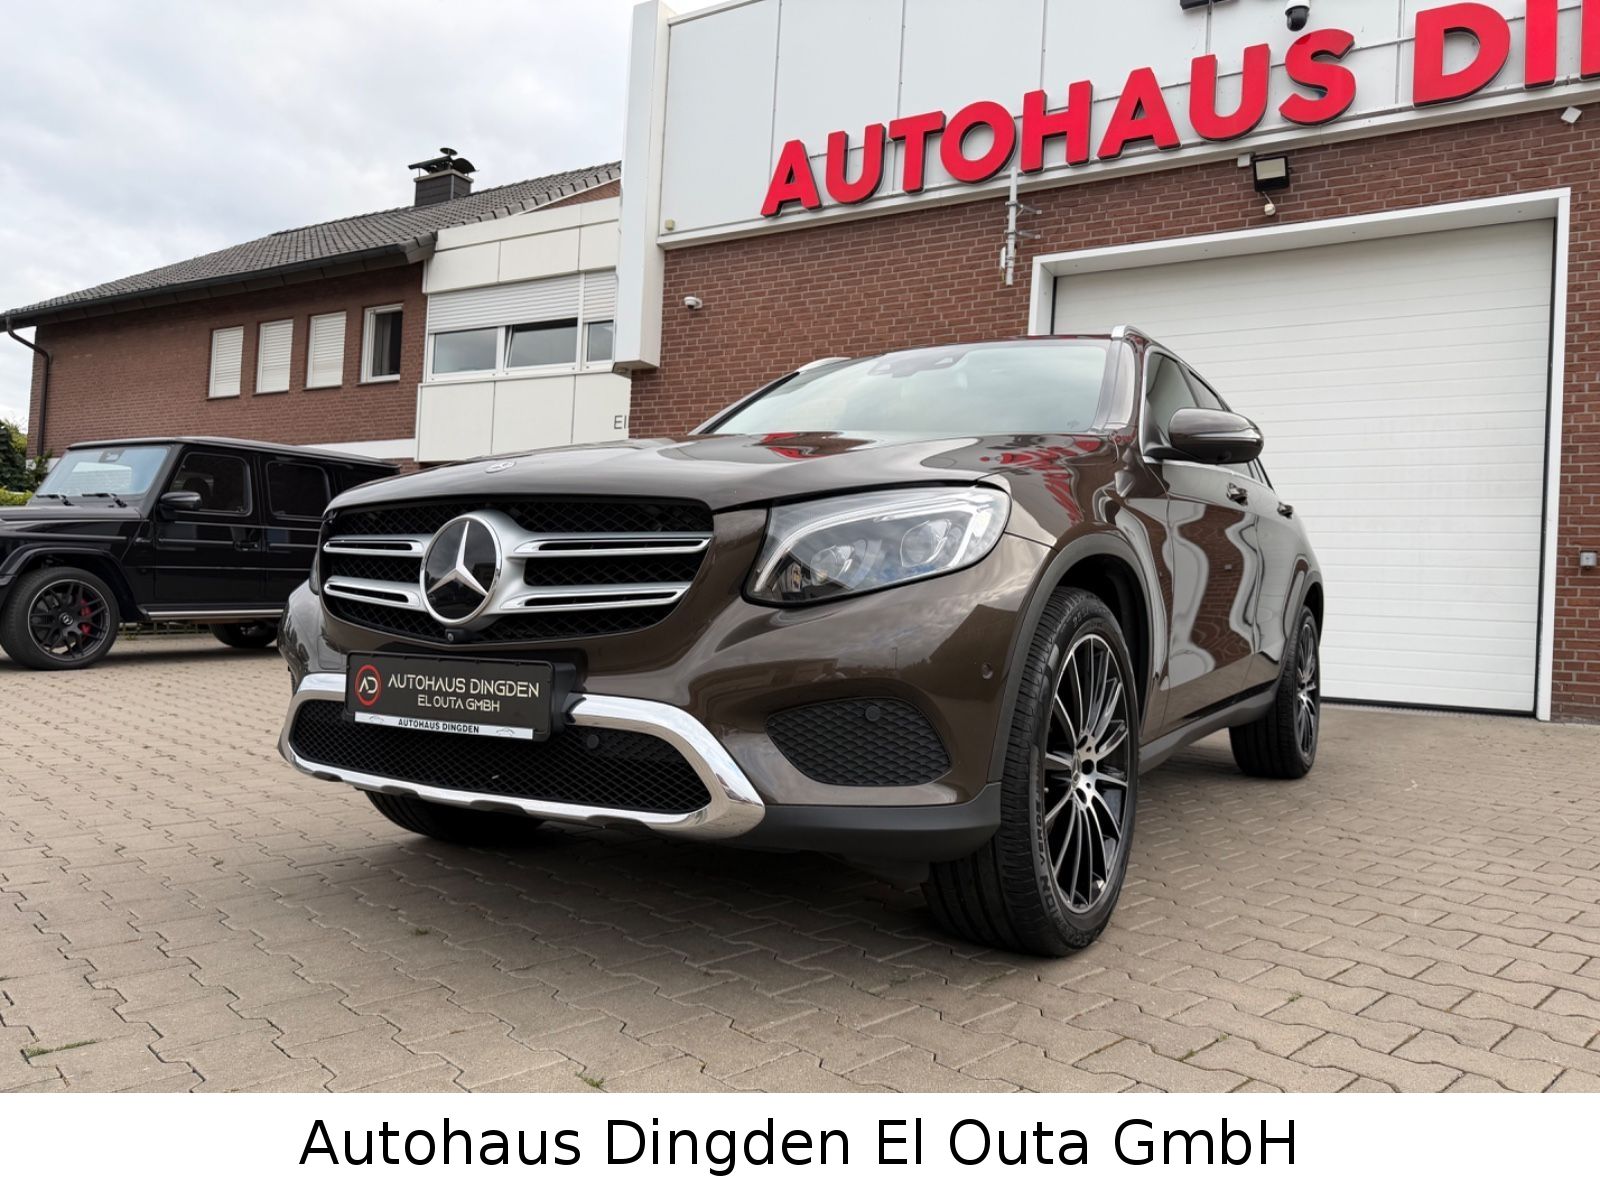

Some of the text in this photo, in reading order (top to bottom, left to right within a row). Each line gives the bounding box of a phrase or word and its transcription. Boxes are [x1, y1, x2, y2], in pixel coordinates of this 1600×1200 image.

[760, 28, 1357, 217] AUTOHAUS
[387, 673, 540, 698] AUTOHAUS DINGDEN
[417, 694, 500, 712] EL OUTA GMBH
[398, 718, 480, 734] AUTOHAUS DINGDEN
